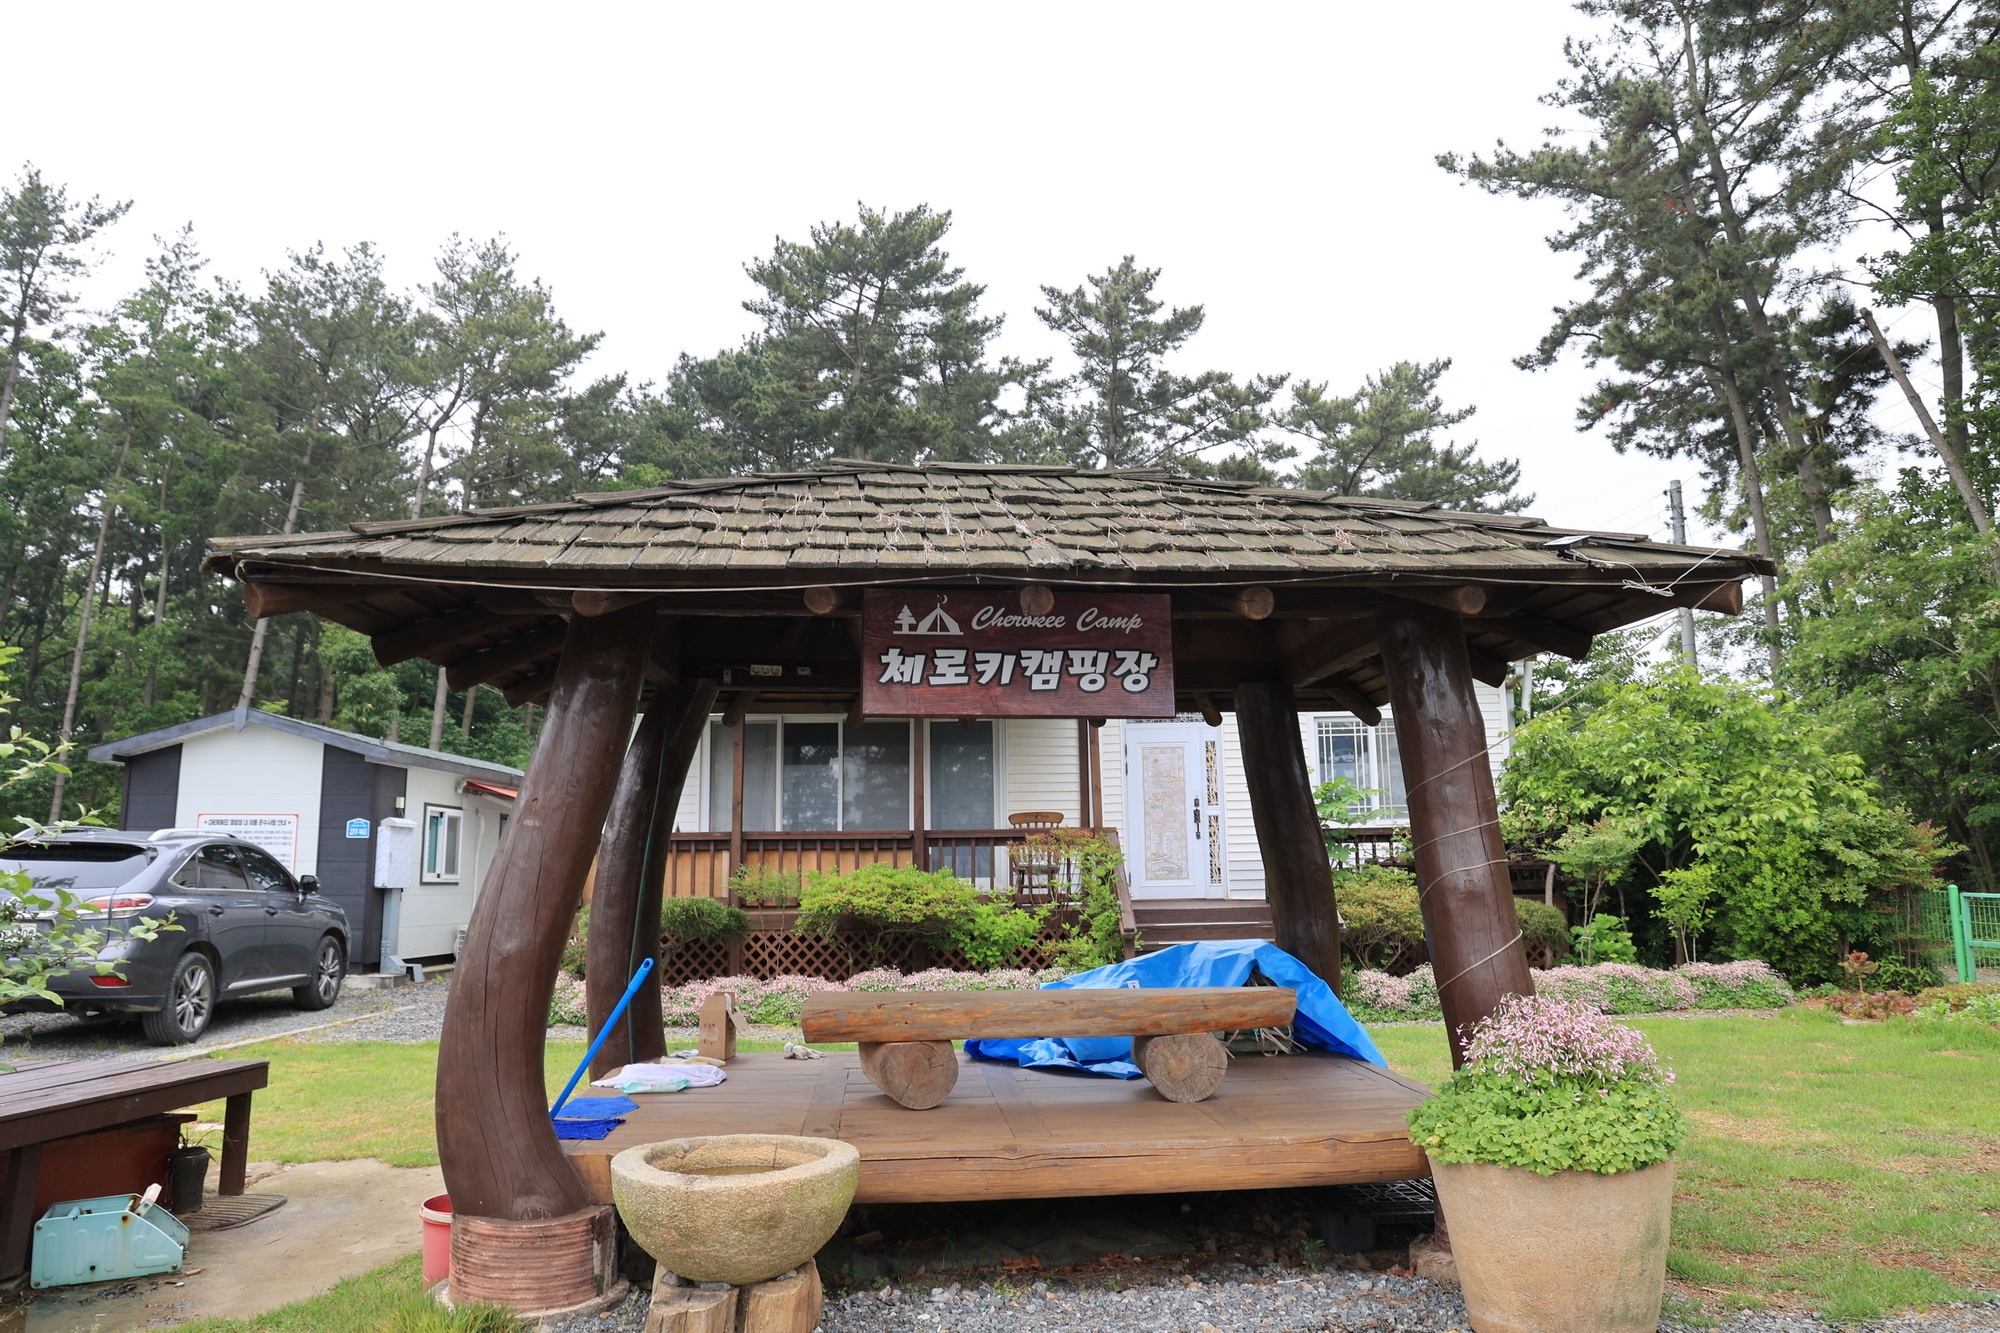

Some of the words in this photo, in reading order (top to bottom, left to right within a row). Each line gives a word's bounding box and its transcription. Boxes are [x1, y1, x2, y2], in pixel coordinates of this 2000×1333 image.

[971, 605, 1066, 631] Cherokee
[1076, 607, 1143, 634] Camp
[878, 647, 1160, 693] 체로키캠핑장
